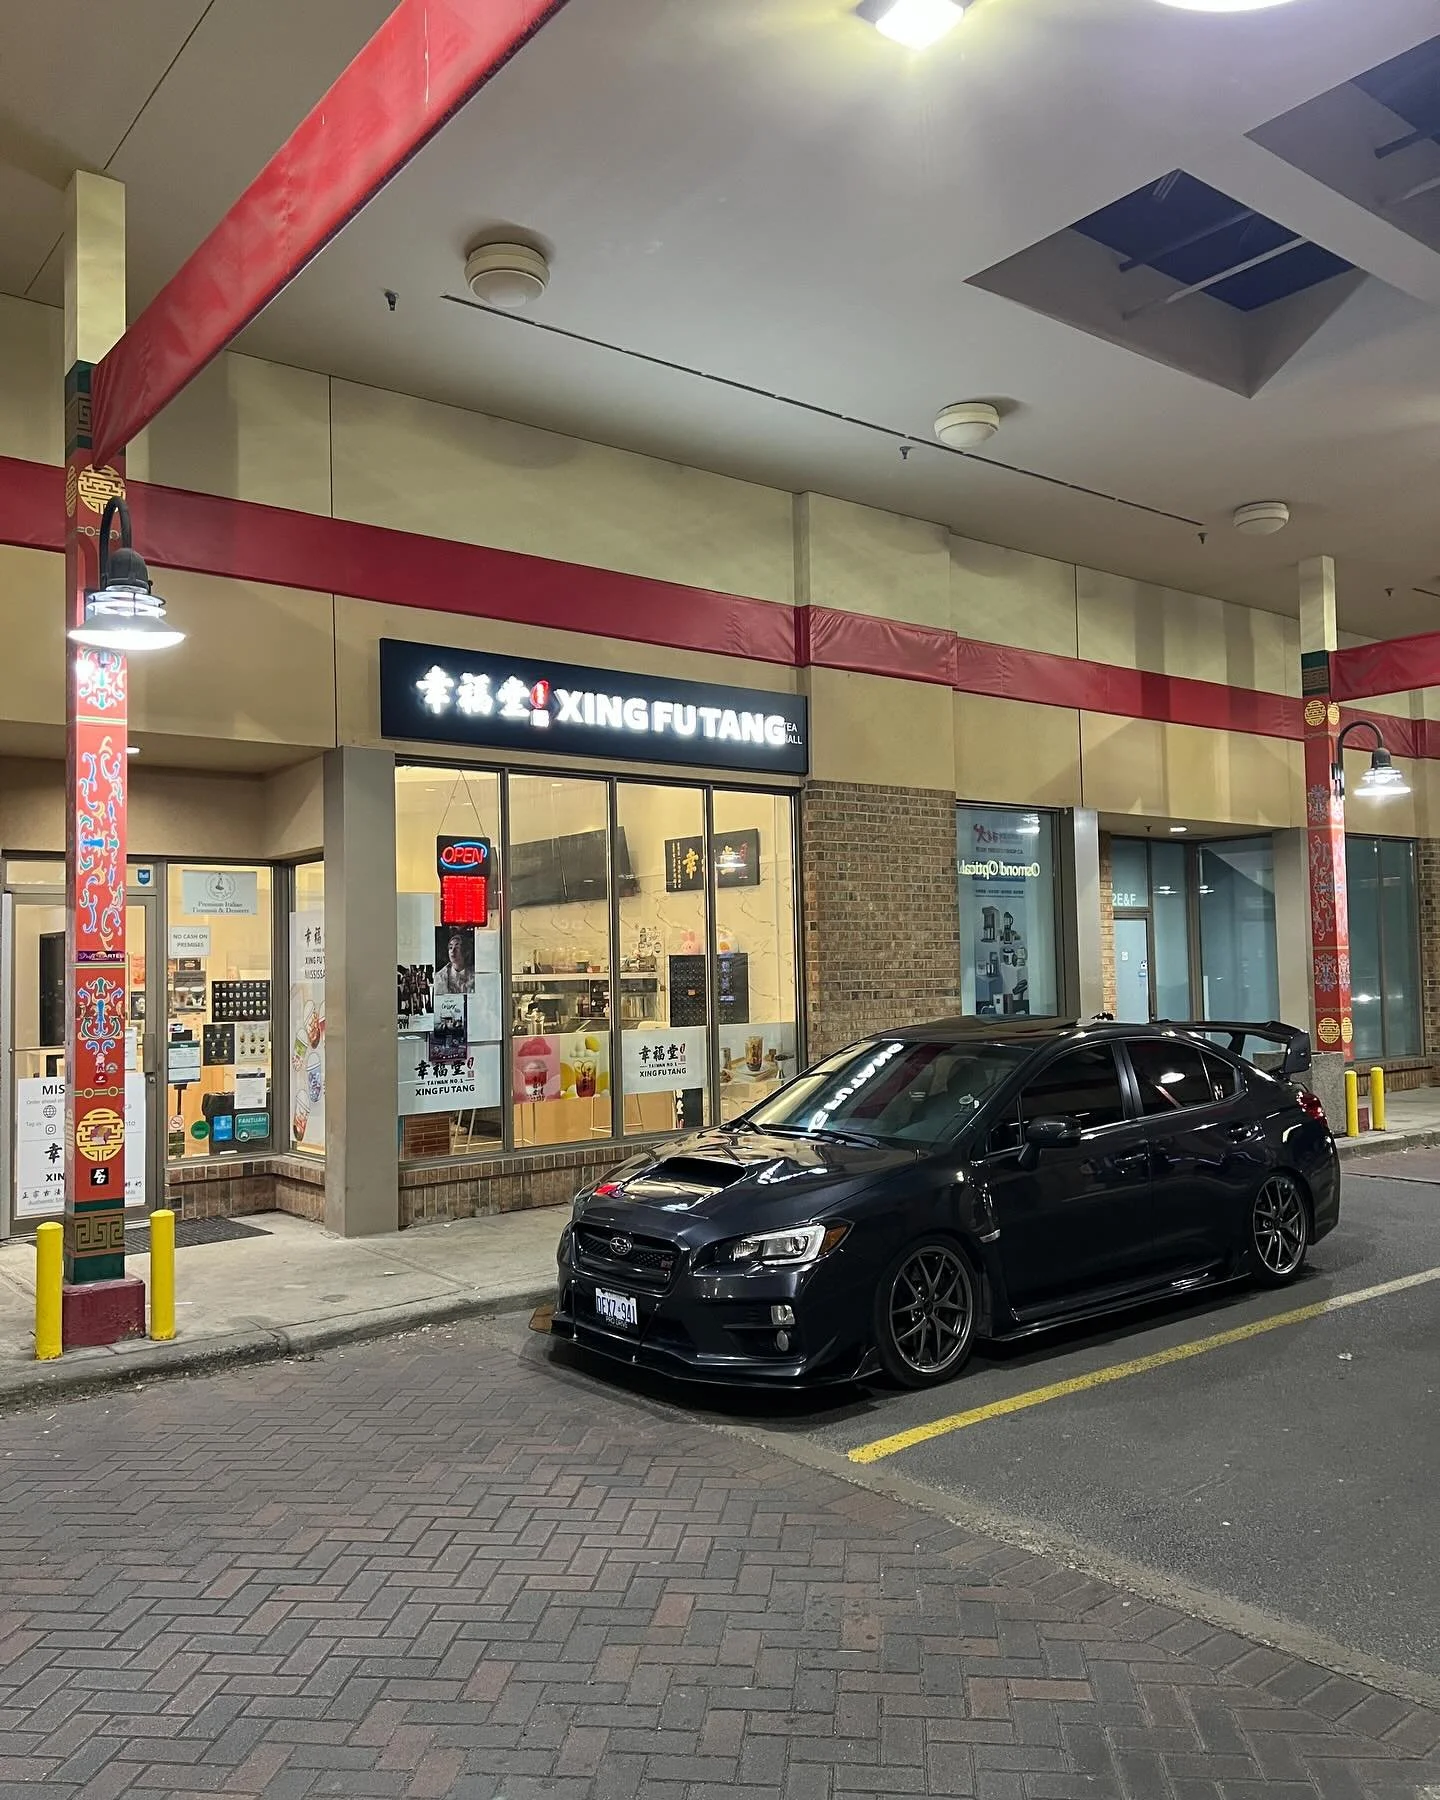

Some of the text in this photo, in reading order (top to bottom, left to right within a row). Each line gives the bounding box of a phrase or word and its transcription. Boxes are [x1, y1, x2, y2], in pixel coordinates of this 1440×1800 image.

[554, 688, 786, 745] XING FU TANG
[442, 846, 484, 864] OPEN
[638, 1043, 679, 1063] 幸福堂
[639, 1069, 657, 1078] XING
[667, 1067, 687, 1075] TANG
[415, 1084, 475, 1097] XING FU TANG
[238, 1116, 267, 1124] FANTUAN
